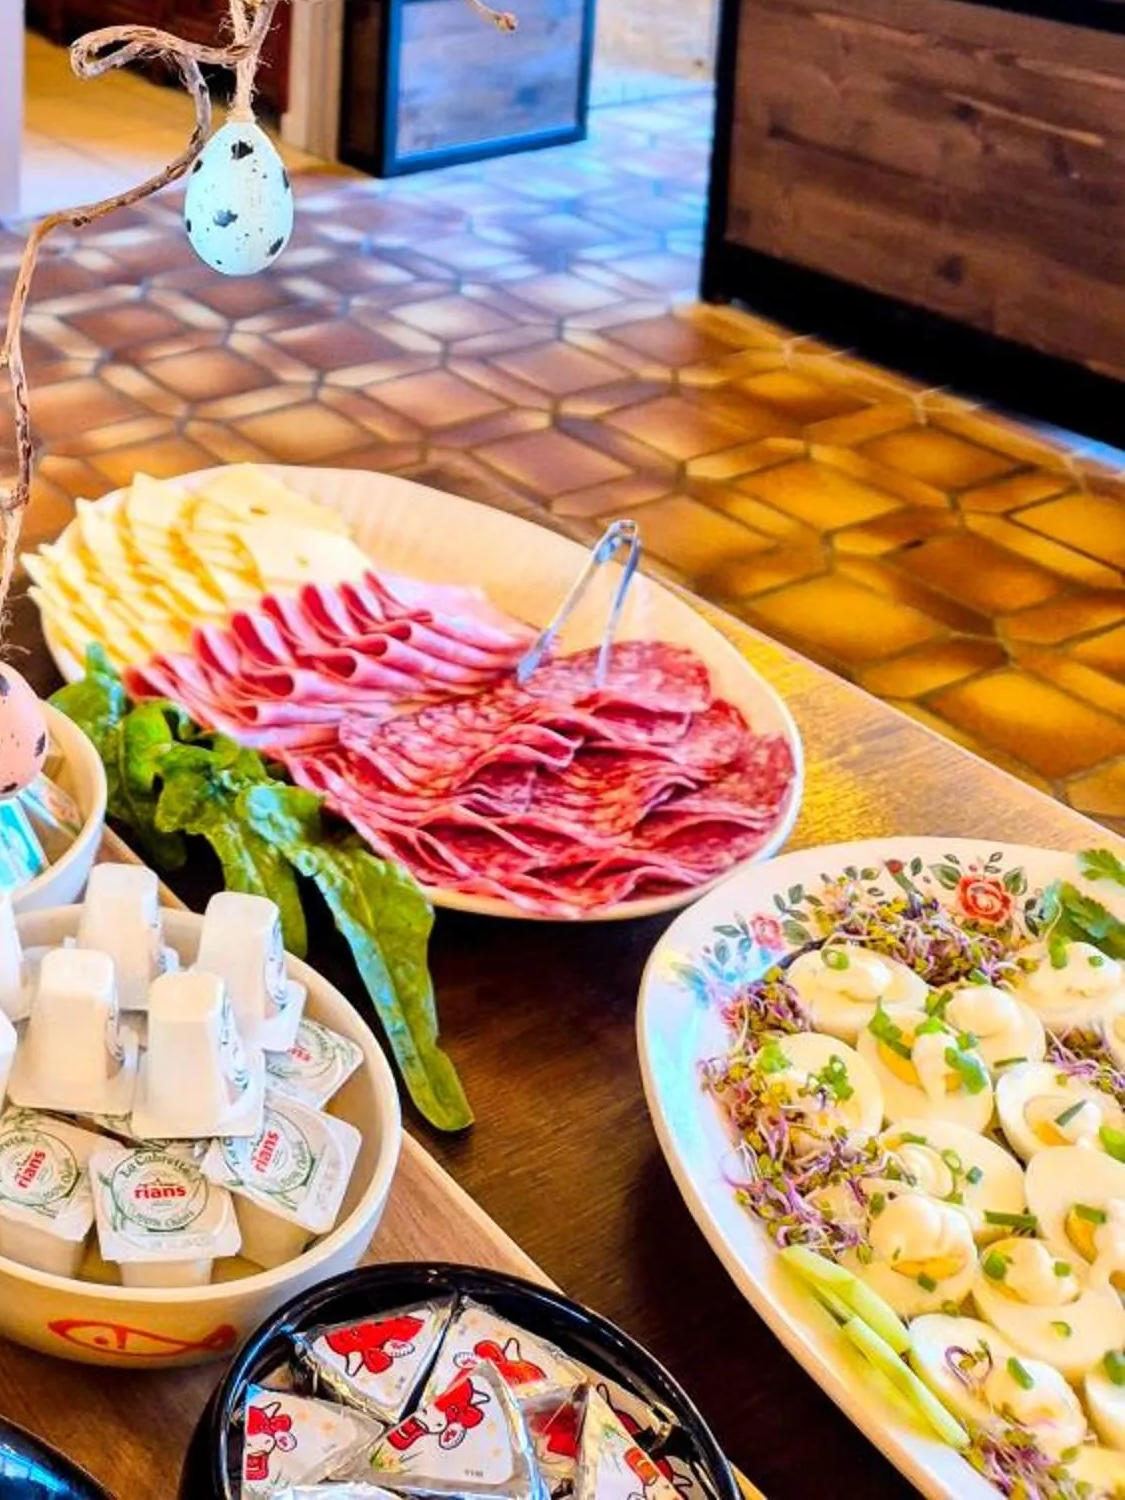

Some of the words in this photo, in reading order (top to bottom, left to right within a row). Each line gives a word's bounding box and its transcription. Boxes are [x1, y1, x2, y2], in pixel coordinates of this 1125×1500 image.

[17, 1149, 47, 1189] rians
[254, 1129, 280, 1173] rians
[133, 1186, 187, 1200] rians
